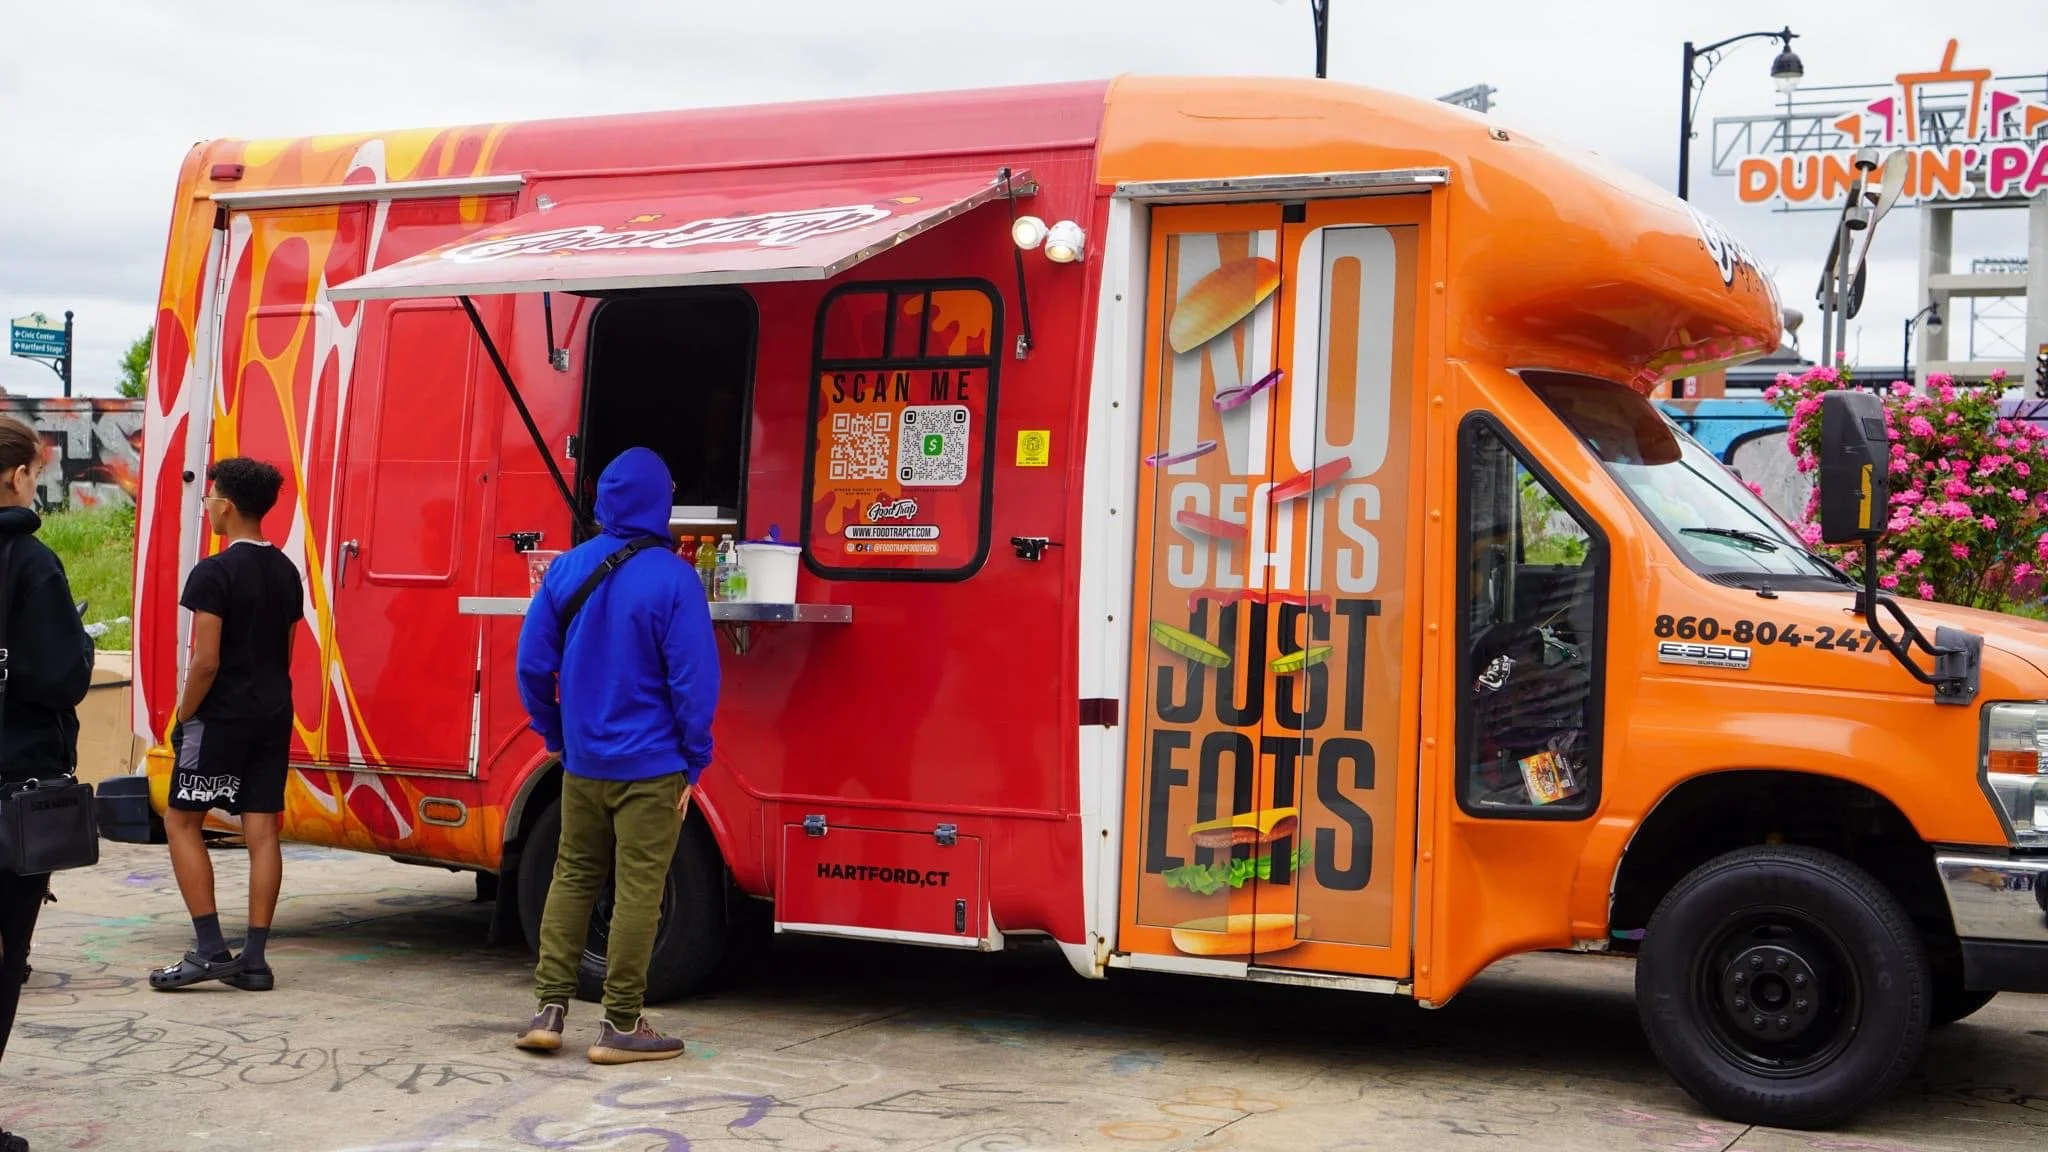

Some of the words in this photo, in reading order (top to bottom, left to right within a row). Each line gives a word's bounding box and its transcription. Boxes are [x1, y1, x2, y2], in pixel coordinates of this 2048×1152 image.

[20, 343, 45, 352] Hartford
[46, 344, 63, 354] Stage
[21, 330, 35, 339] Civic
[36, 331, 55, 340] Center
[1167, 223, 1396, 478] NO
[832, 372, 912, 404] SCAN
[930, 371, 971, 401] ME
[1167, 481, 1381, 594] SEATS
[1654, 614, 1899, 653] 860-804-247
[1156, 596, 1382, 731] JUST
[817, 863, 950, 888] HARTFORD,CT
